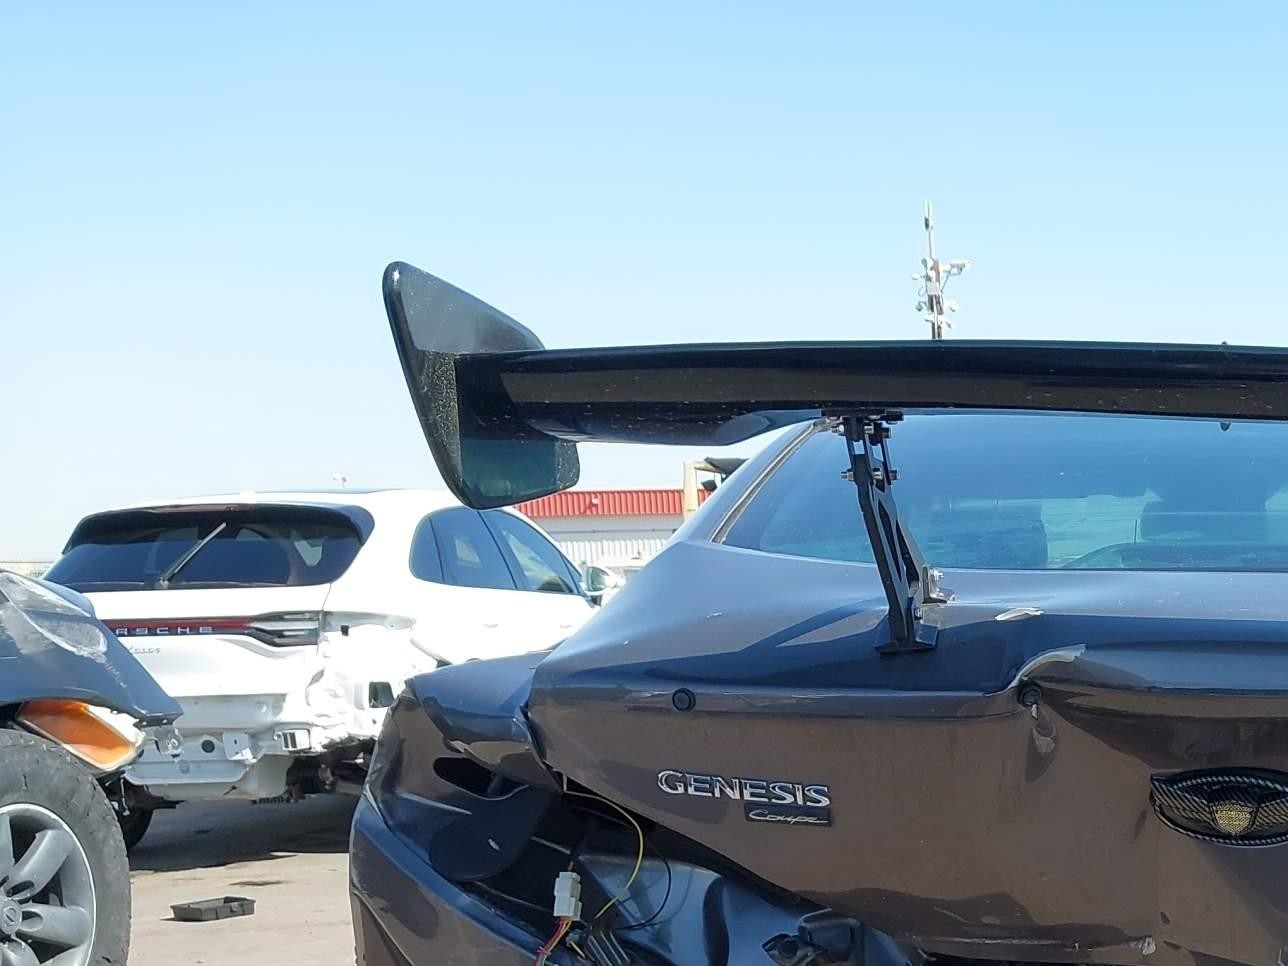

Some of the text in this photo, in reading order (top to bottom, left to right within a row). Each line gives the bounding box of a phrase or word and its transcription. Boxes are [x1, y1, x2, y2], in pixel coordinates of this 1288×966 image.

[115, 626, 213, 636] RSCHE
[657, 769, 831, 807] GENESIS
[748, 808, 829, 825] Coupe
